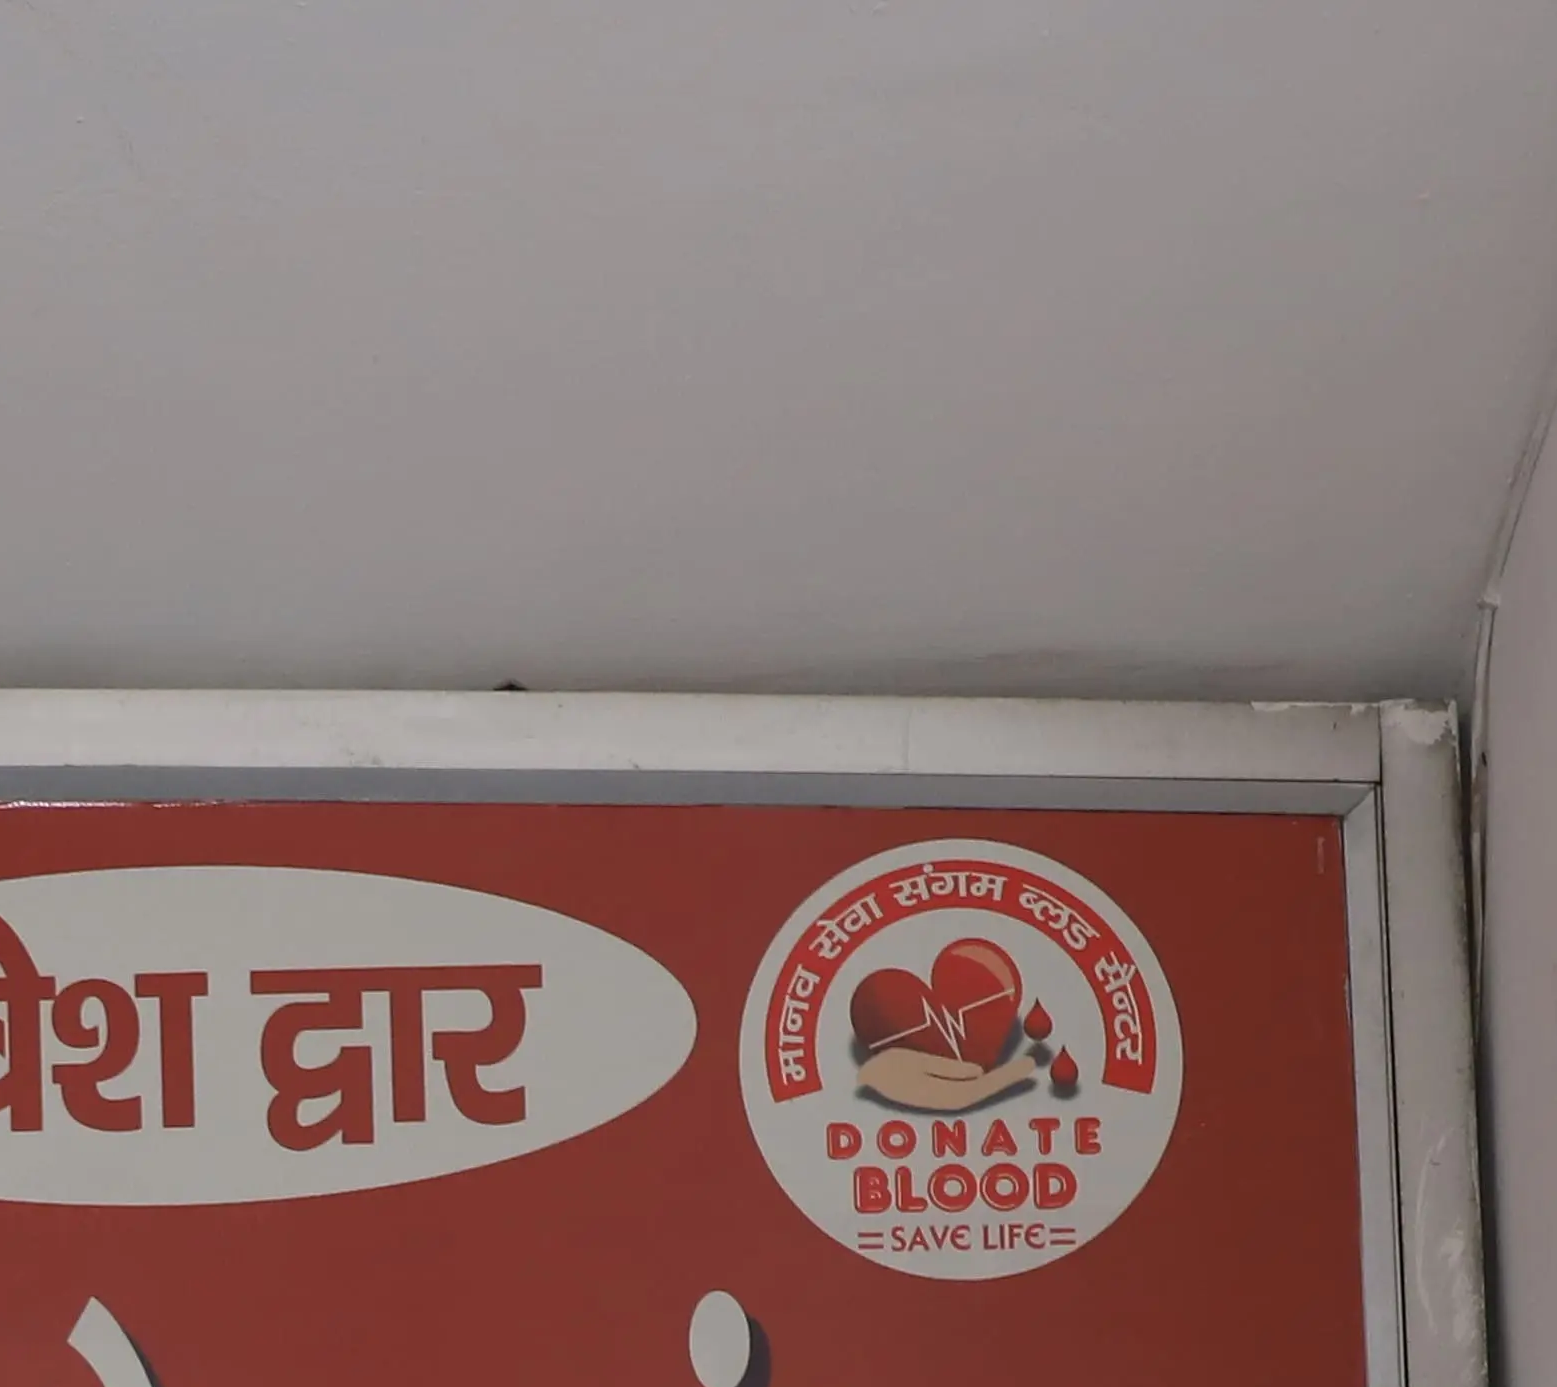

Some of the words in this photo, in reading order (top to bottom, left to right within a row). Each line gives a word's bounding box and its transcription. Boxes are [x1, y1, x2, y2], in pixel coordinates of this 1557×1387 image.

[777, 964, 822, 1087] मानव
[808, 892, 885, 961] सेवा
[889, 863, 1009, 909] संगम
[249, 963, 543, 1152] द्वार
[825, 1117, 1103, 1160] DONATE
[852, 1163, 1078, 1214] BLOOD
[891, 1225, 971, 1253] SAVE
[982, 1223, 1046, 1251] LIFE
